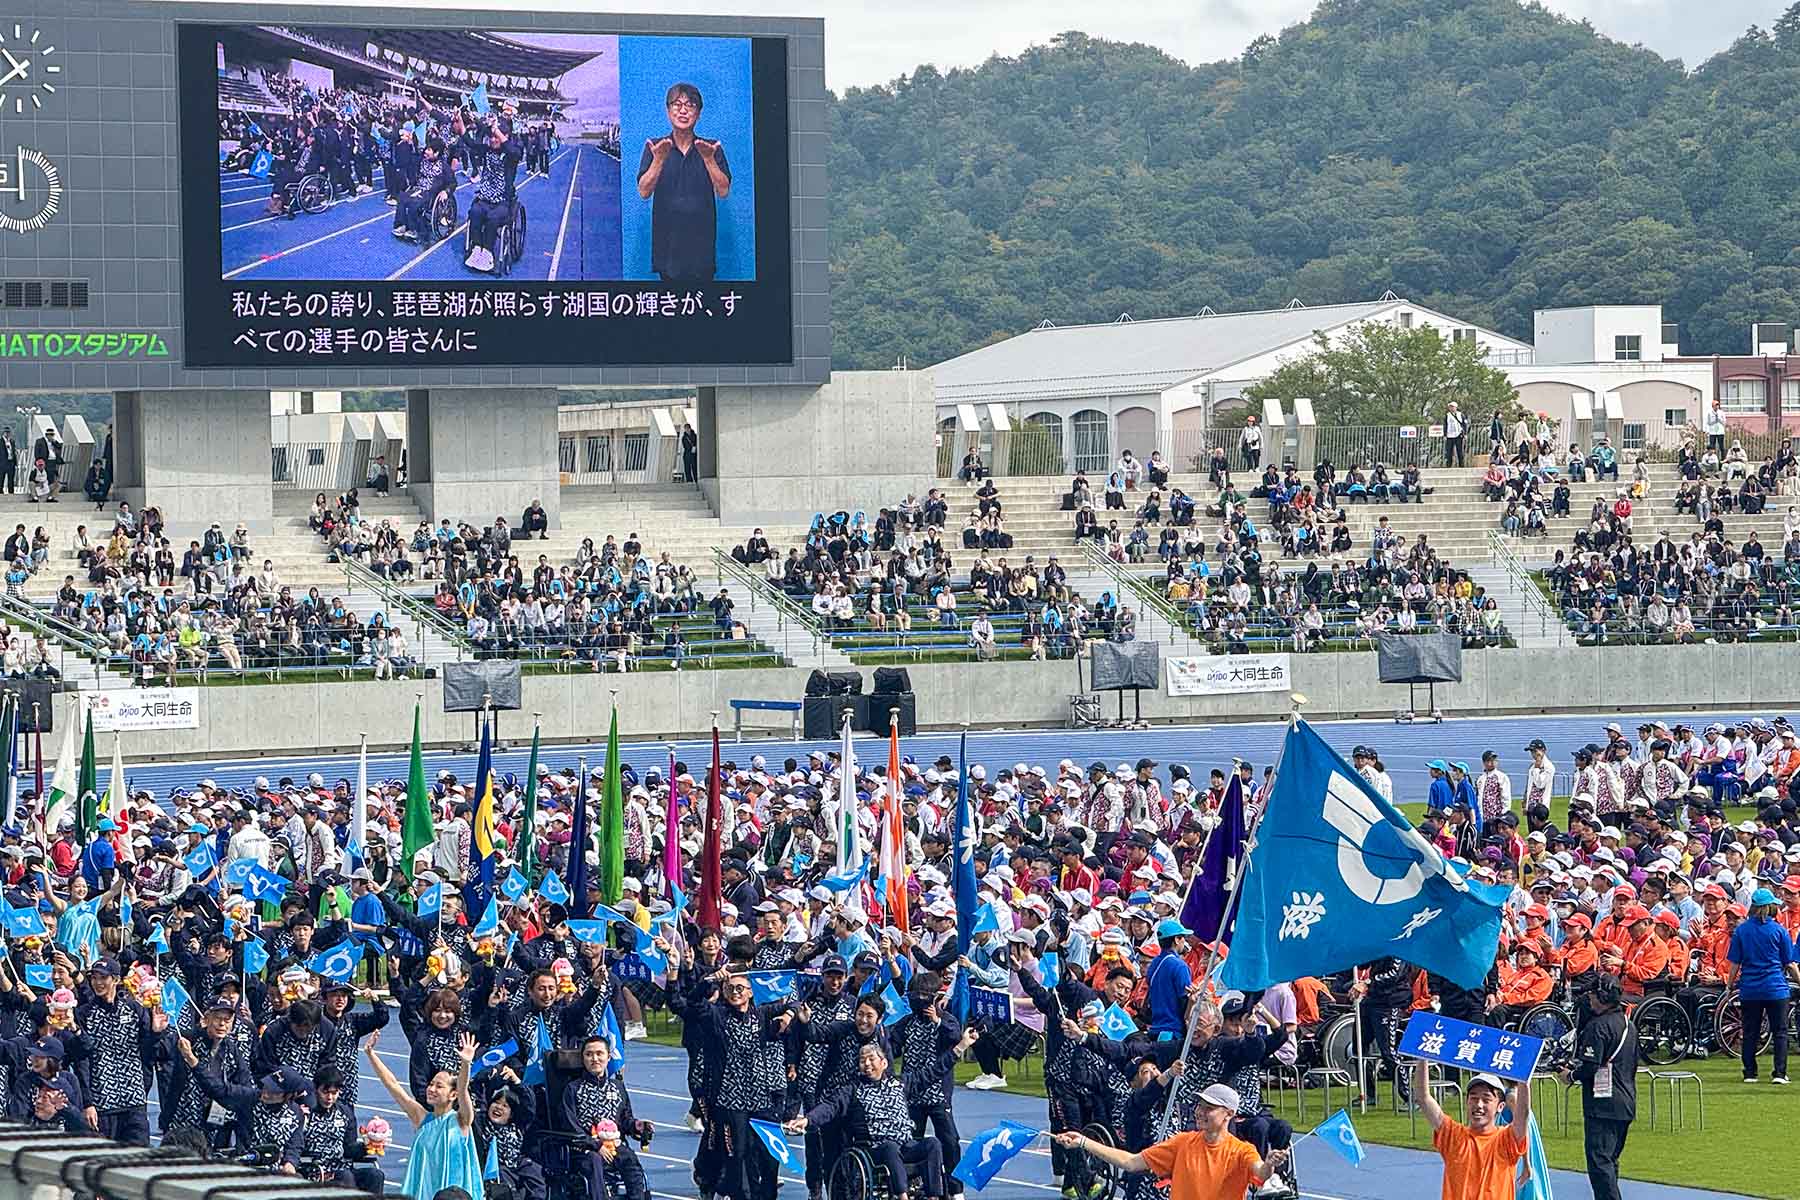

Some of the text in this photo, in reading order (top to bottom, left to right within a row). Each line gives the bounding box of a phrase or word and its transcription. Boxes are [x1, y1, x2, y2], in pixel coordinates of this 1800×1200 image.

[232, 291, 743, 317] 私たちの誇り、琵琶湖が照らす湖国の輝きが、す
[233, 327, 478, 354] べての選手の皆さんに
[1229, 666, 1284, 681] 大同生命
[141, 701, 193, 717] 大同生命
[1417, 1031, 1515, 1071] 滋賀県
